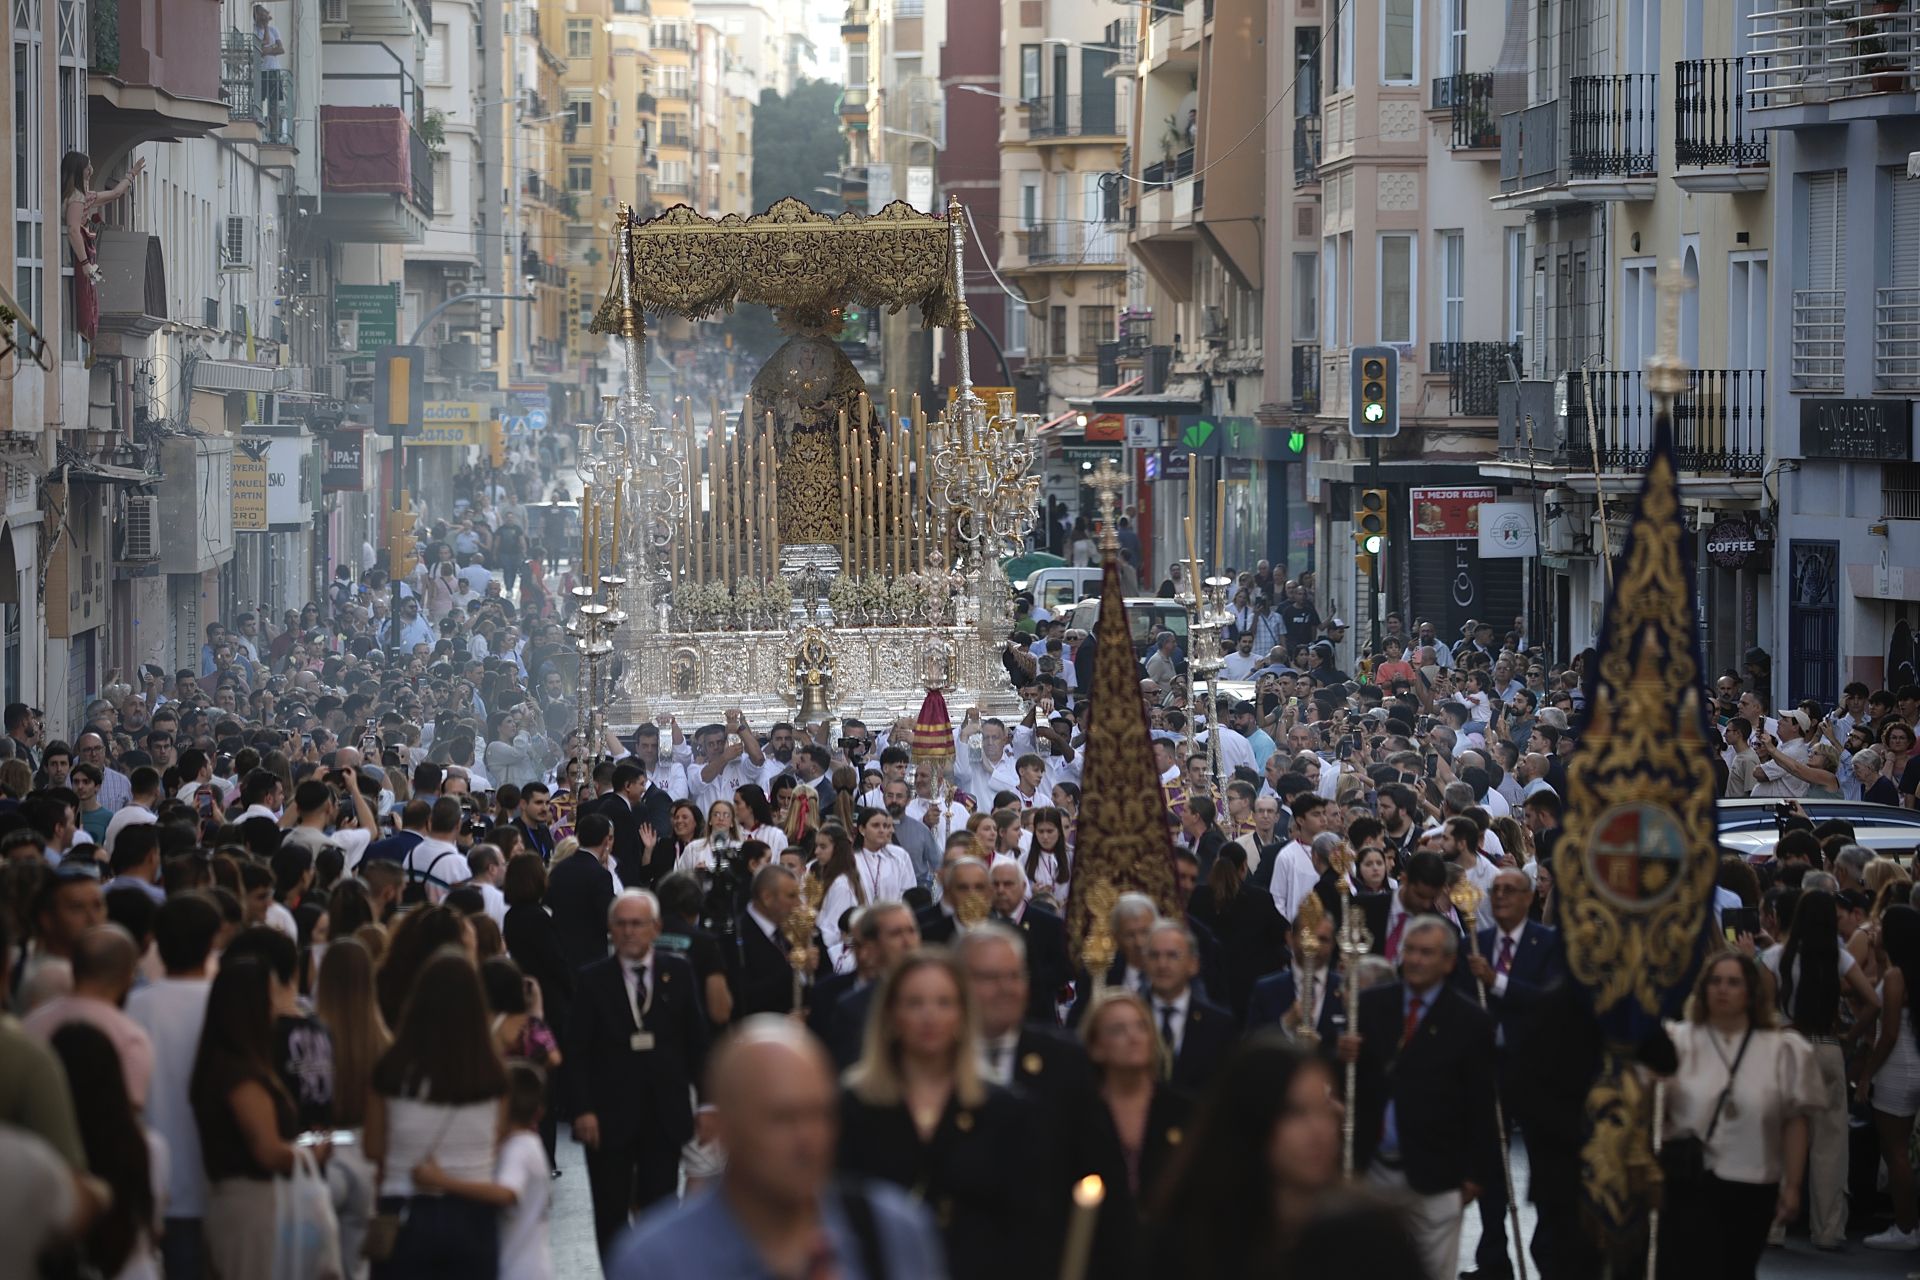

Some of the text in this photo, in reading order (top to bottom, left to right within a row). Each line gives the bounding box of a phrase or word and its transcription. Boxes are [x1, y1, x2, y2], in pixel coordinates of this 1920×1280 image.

[569, 277, 578, 357] FARMACIA
[1853, 406, 1887, 433] DENTAL
[1428, 491, 1459, 499] MEJOR
[1462, 490, 1494, 499] KEBAB
[1706, 541, 1756, 552] COFFEE
